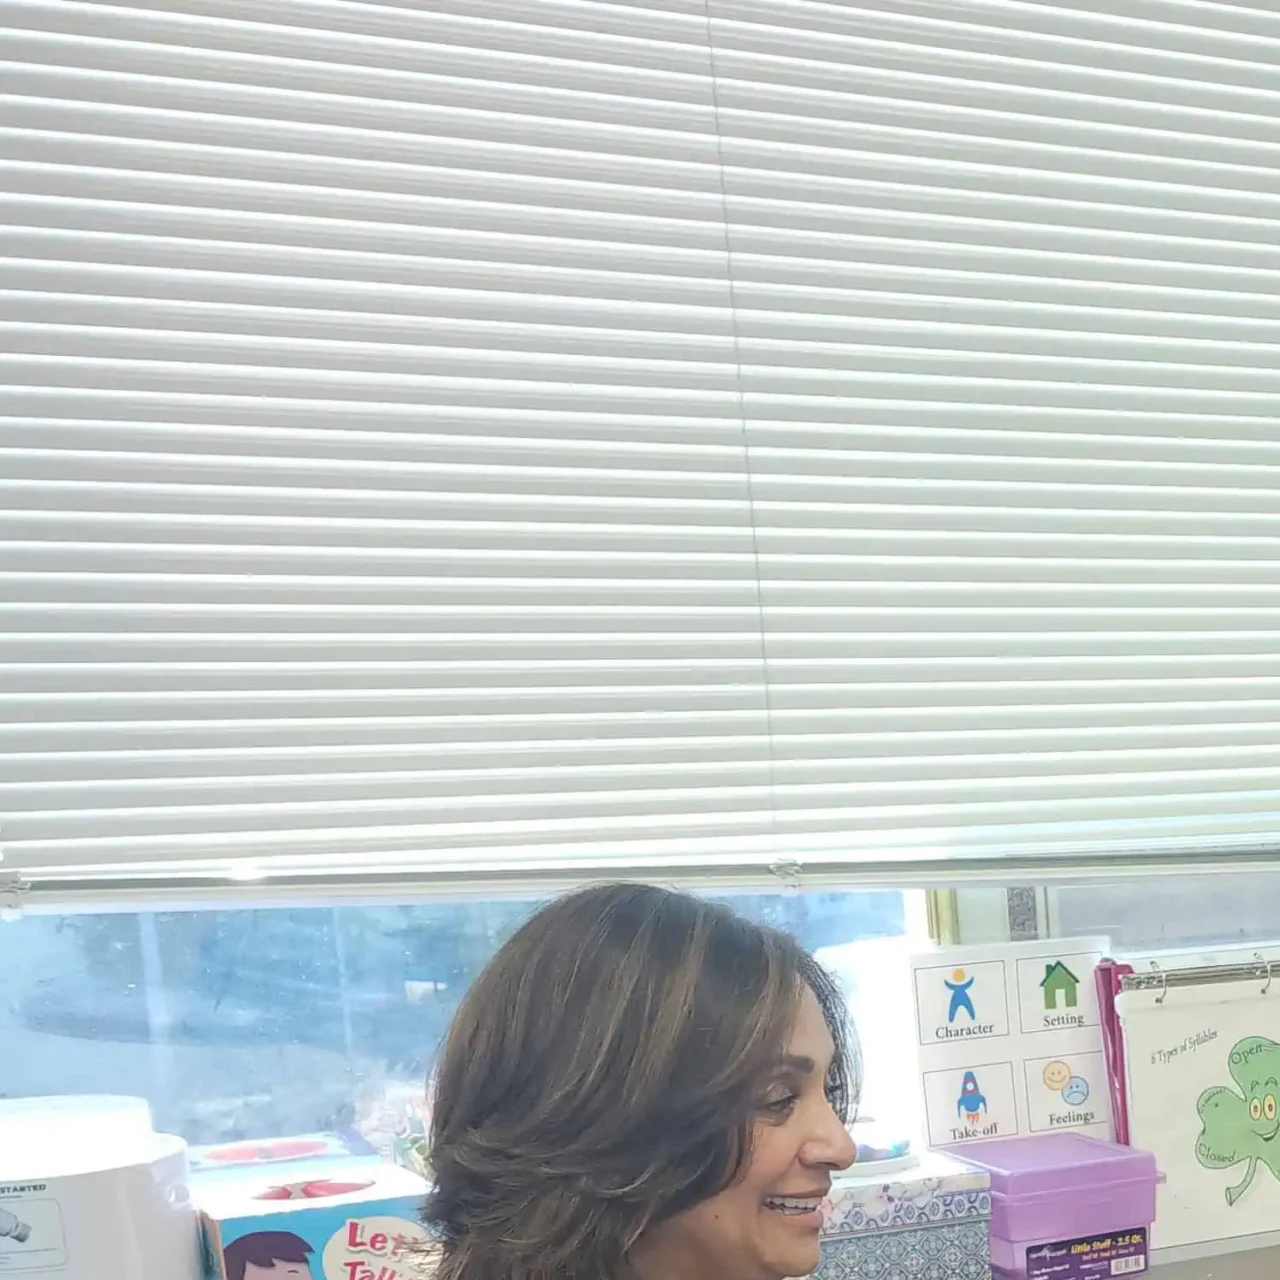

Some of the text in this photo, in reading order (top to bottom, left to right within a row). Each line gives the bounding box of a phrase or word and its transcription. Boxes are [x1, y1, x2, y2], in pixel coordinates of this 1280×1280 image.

[1042, 1013, 1084, 1028] Setting
[935, 1023, 995, 1039] Character
[1230, 1043, 1264, 1065] Open
[1048, 1110, 1096, 1126] Feelings
[950, 1122, 999, 1140] Take-off
[1197, 1143, 1236, 1162] Closed
